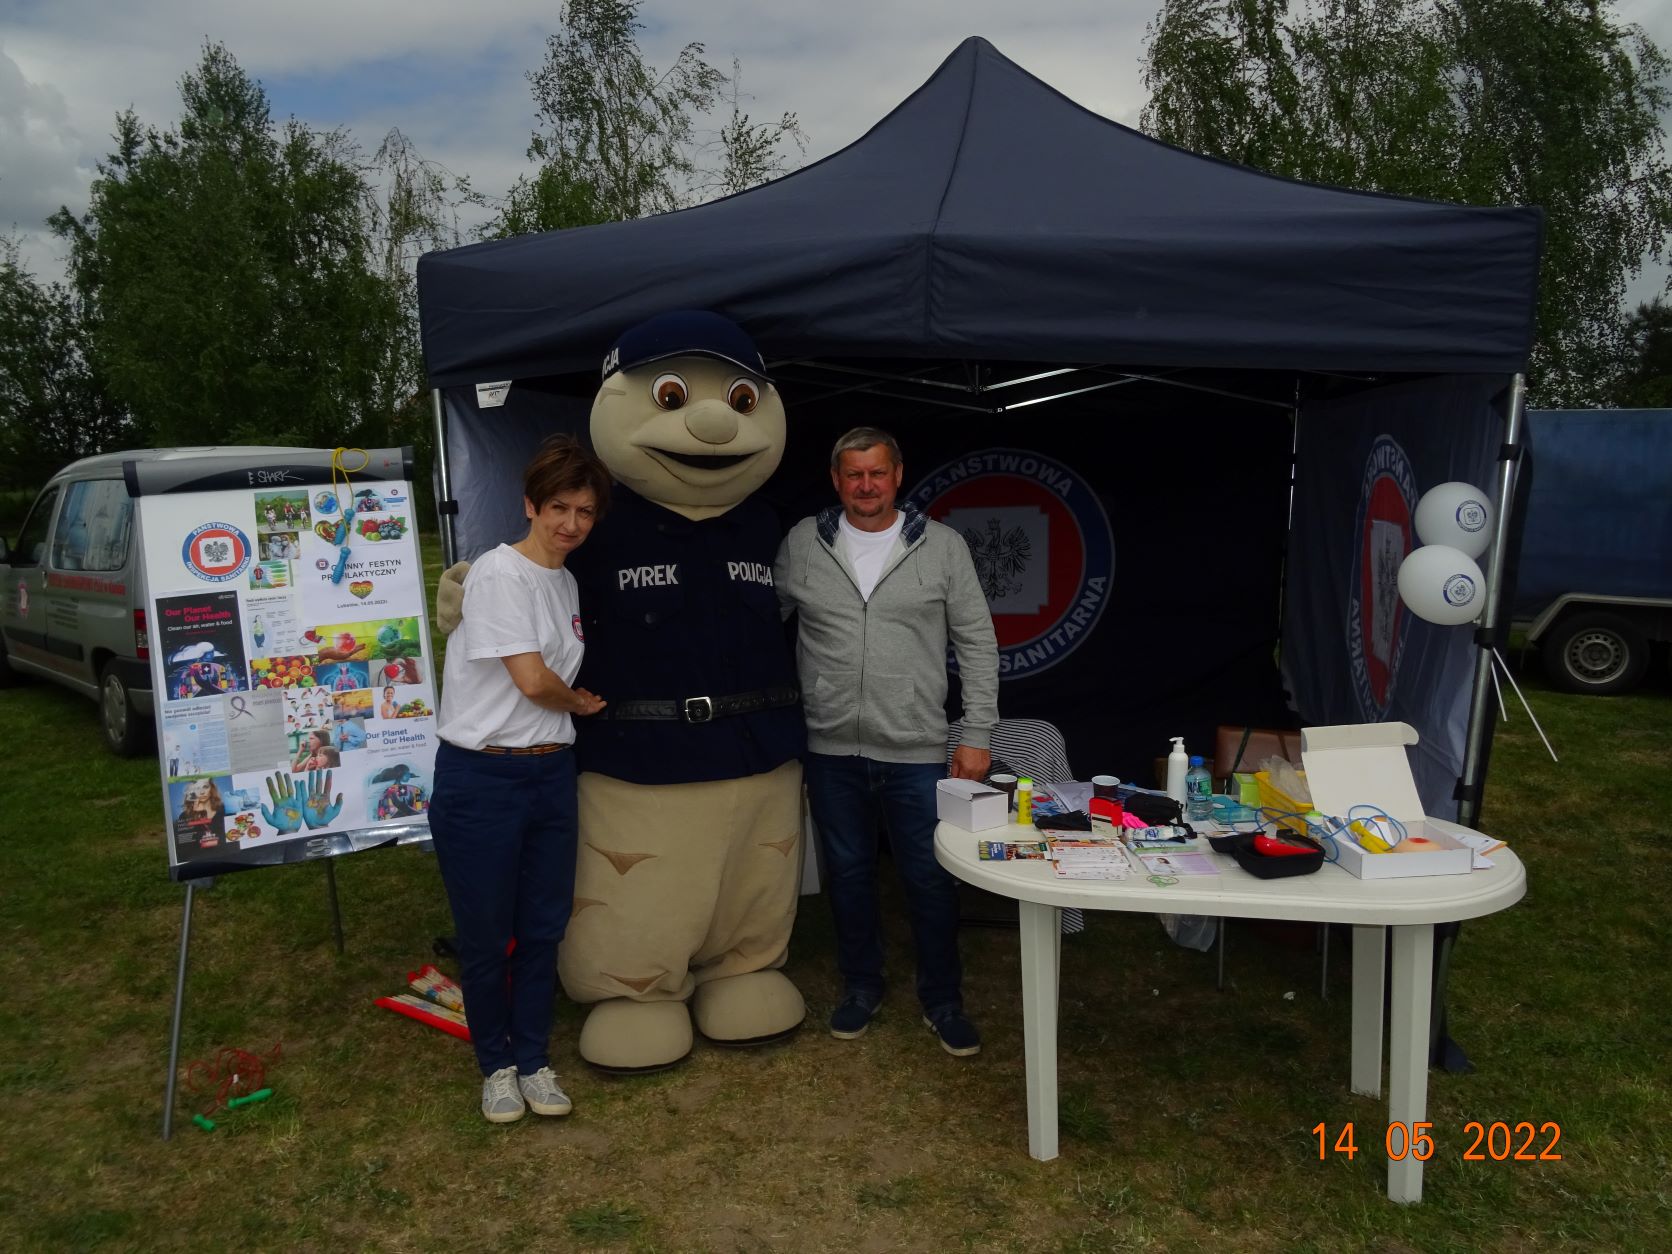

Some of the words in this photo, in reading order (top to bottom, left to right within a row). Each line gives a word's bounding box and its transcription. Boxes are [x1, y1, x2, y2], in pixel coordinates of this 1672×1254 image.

[257, 469, 304, 483] SHARK
[369, 559, 401, 568] FESTYN
[618, 564, 679, 591] PYREK
[728, 561, 774, 587] POLICJA
[183, 605, 212, 615] Planet
[202, 611, 231, 620] Health
[999, 576, 1107, 673] SANITARNA
[382, 728, 408, 737] Planet
[383, 737, 397, 745] Our
[399, 733, 426, 743] Health
